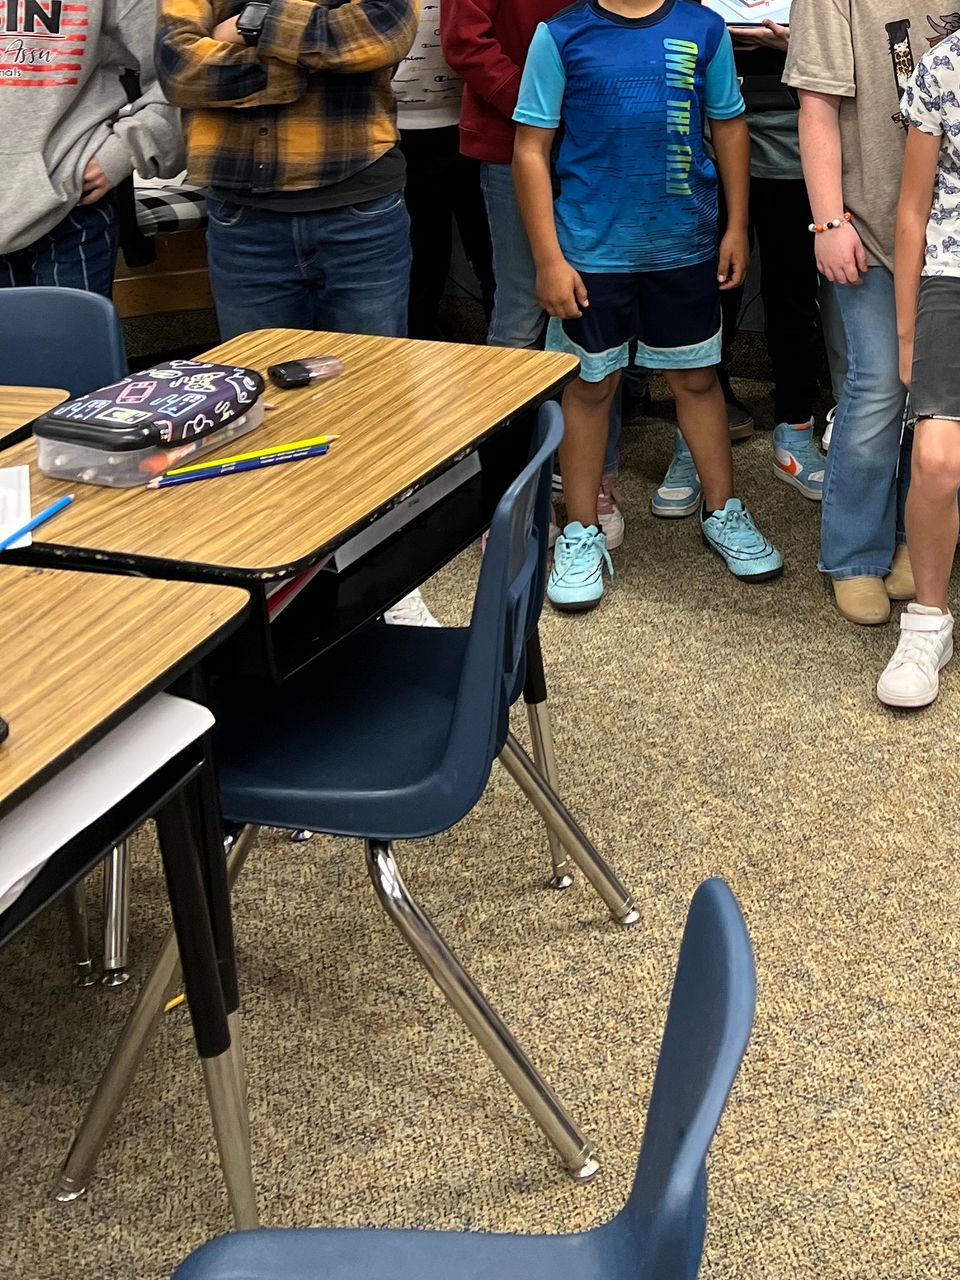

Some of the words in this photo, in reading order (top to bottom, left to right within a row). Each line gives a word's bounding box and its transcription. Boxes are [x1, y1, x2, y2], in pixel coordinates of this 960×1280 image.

[663, 37, 698, 90] OWN
[666, 99, 691, 136] THE
[665, 144, 692, 196] FIELD
